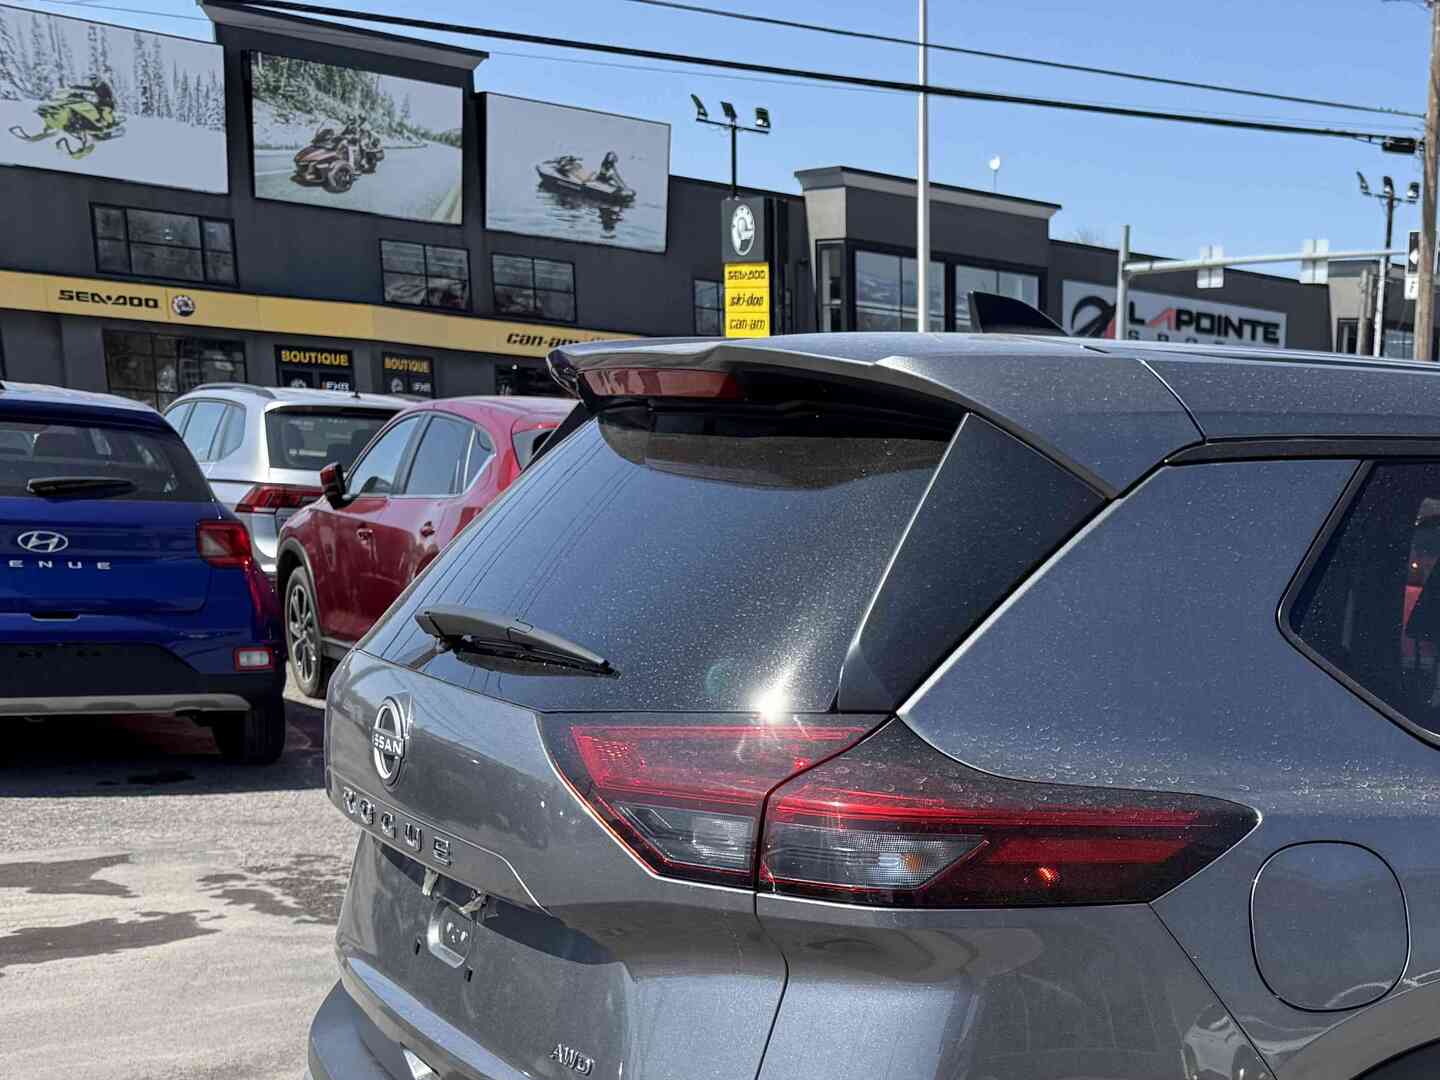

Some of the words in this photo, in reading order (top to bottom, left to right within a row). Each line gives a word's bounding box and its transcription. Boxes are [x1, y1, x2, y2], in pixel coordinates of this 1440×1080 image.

[1128, 302, 1280, 345] LAPOINTE
[281, 350, 350, 367] BOUTIQUE
[383, 356, 432, 373] BOUTIQUE
[548, 1042, 595, 1077] AWD
